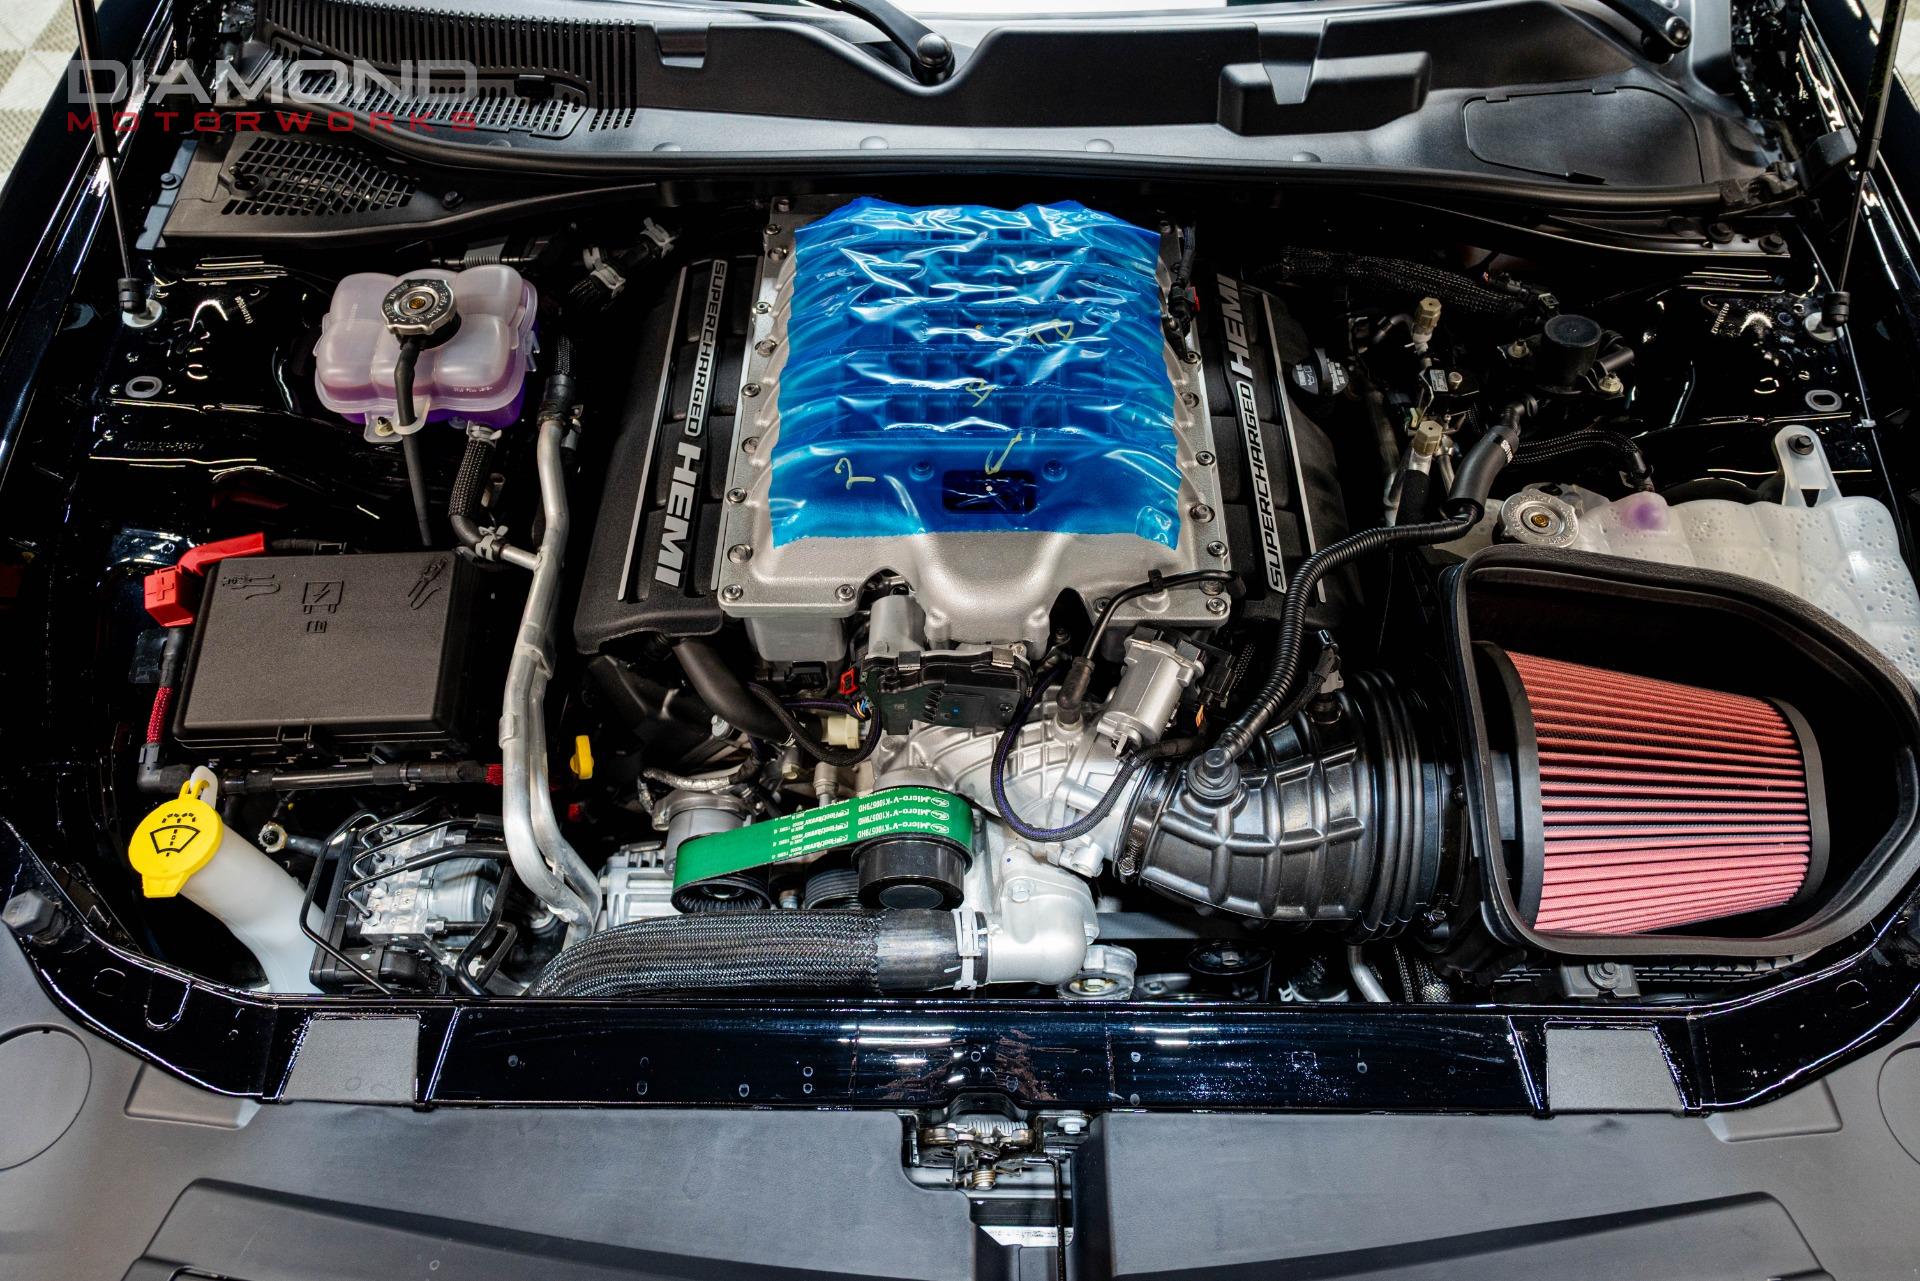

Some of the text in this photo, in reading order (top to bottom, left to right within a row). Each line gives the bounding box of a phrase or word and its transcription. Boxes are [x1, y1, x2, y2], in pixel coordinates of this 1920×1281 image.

[654, 261, 726, 587] SUPERCHARGED HEMI
[1217, 273, 1284, 590] SUPERCHARGED HEMI
